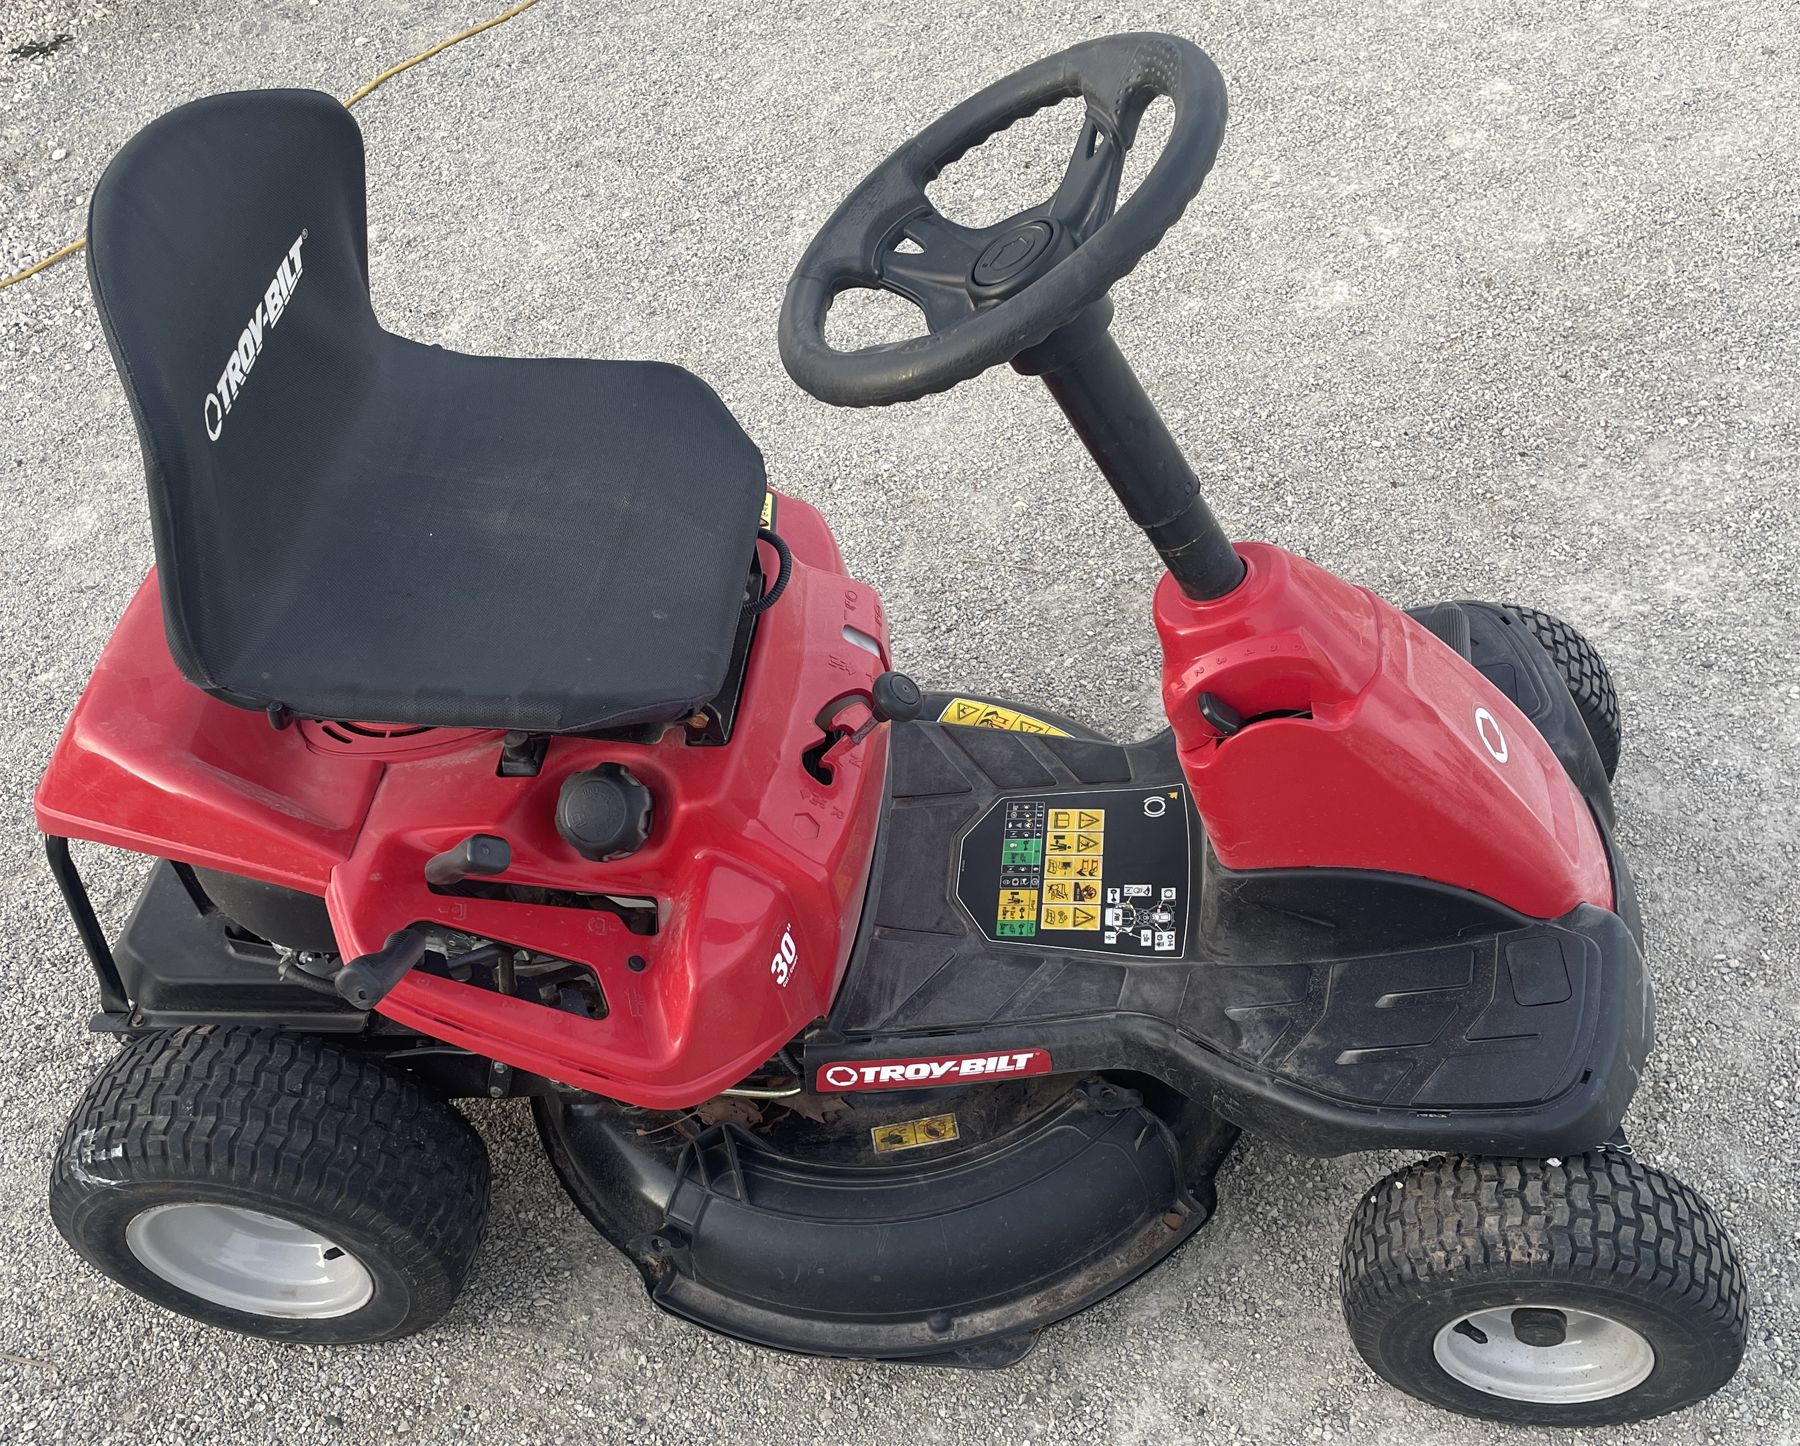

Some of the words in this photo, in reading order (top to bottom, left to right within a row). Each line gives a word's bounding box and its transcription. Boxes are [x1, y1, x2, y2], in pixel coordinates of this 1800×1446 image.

[216, 234, 303, 415] TROY-BILT
[1195, 666, 1205, 677] 2
[1216, 656, 1227, 666] 3
[859, 1052, 1034, 1083] TROY-BILT
